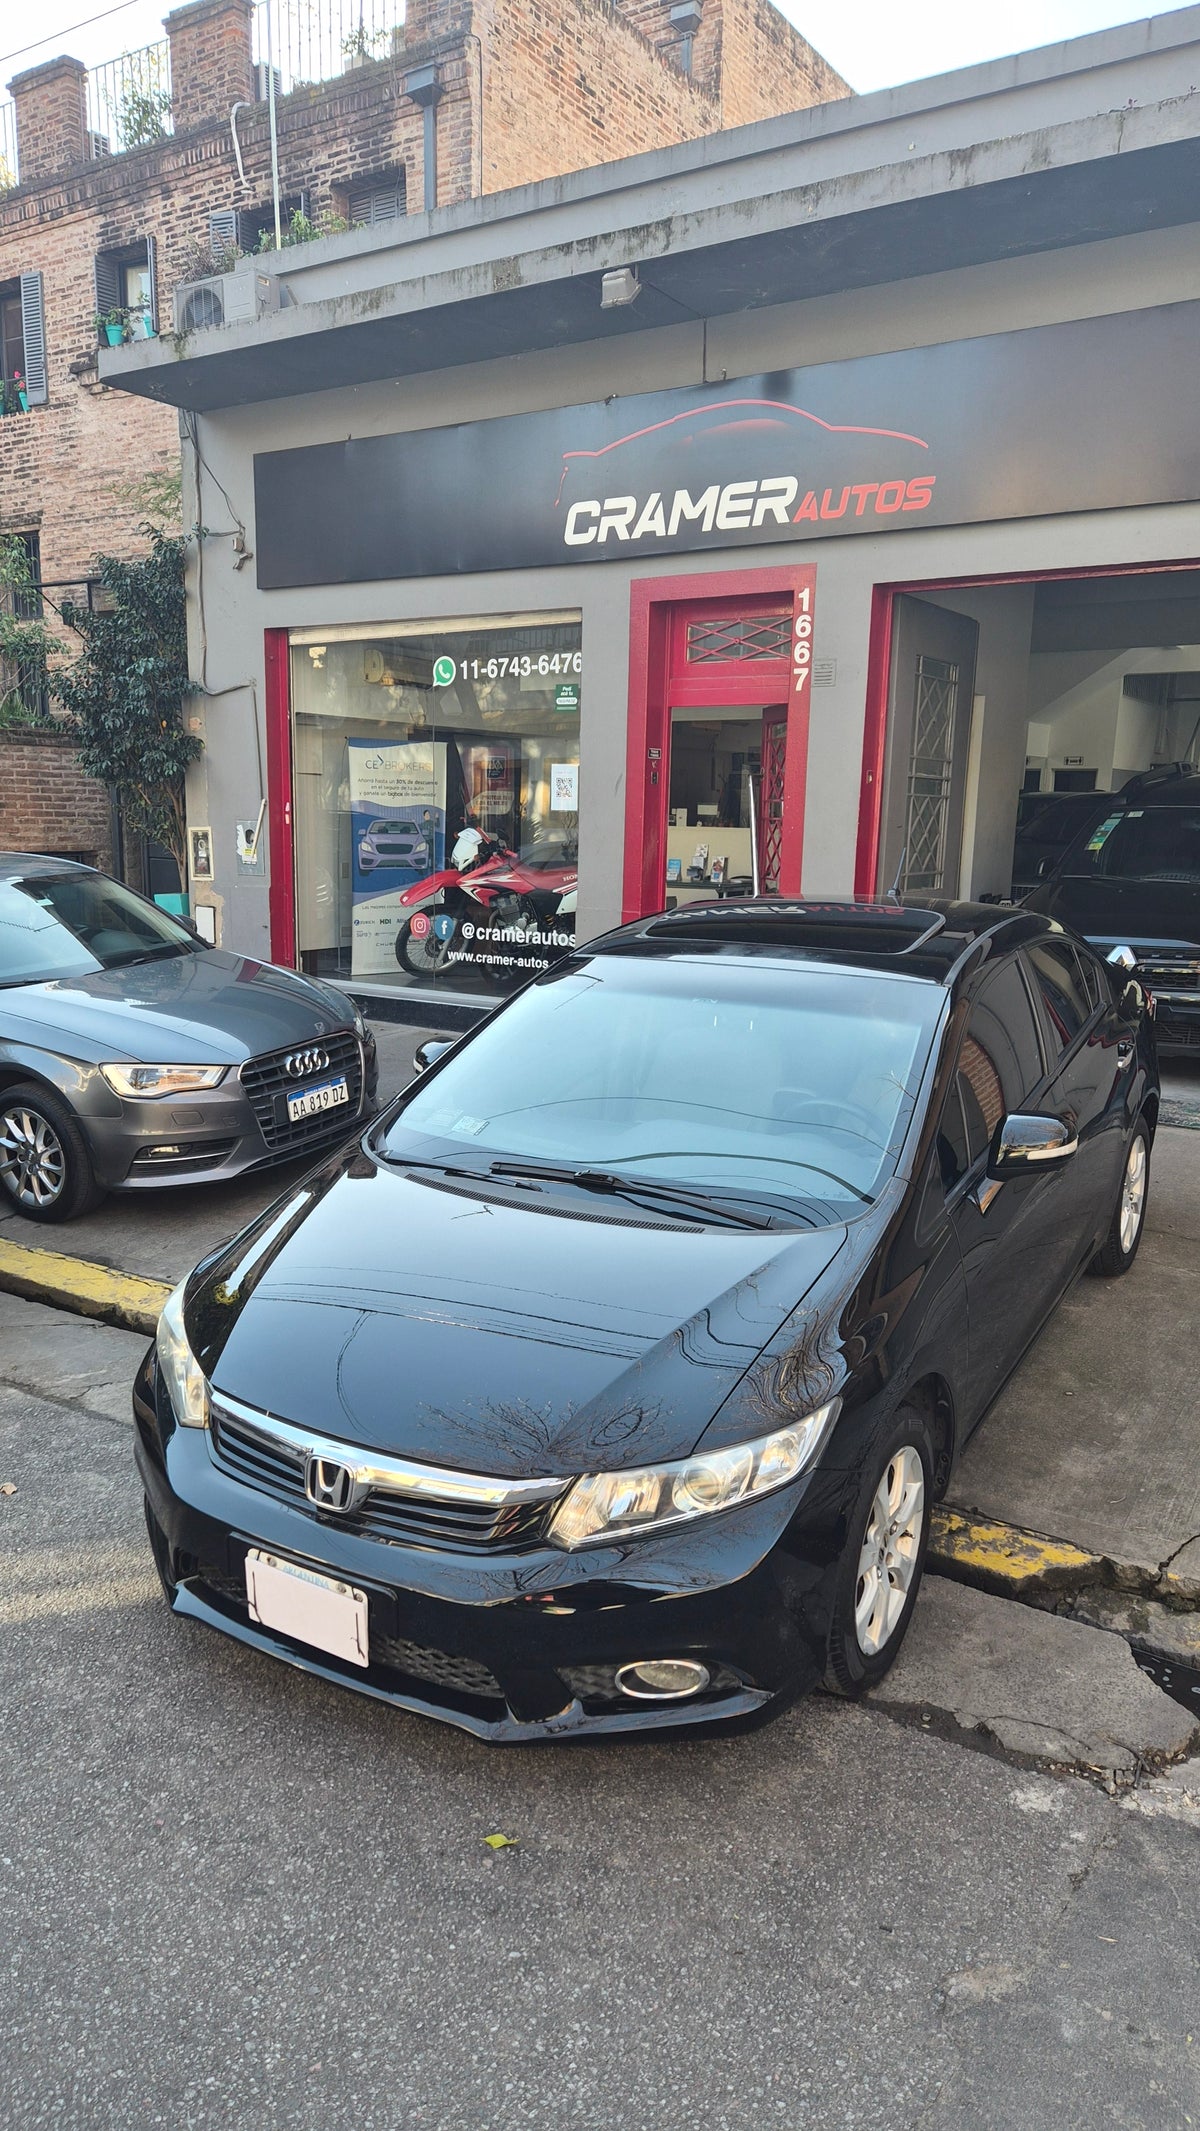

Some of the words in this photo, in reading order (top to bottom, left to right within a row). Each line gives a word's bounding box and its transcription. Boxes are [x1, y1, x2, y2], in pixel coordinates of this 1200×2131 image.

[563, 475, 799, 545] CRAMER
[792, 475, 937, 523] AUTOS
[793, 587, 812, 692] 1667
[460, 652, 582, 680] 11-6743-6476
[365, 760, 379, 770] CE
[461, 922, 576, 947] @cramerautos
[293, 1099, 307, 1118] AA
[309, 1091, 329, 1111] 819
[332, 1085, 346, 1102] DZ
